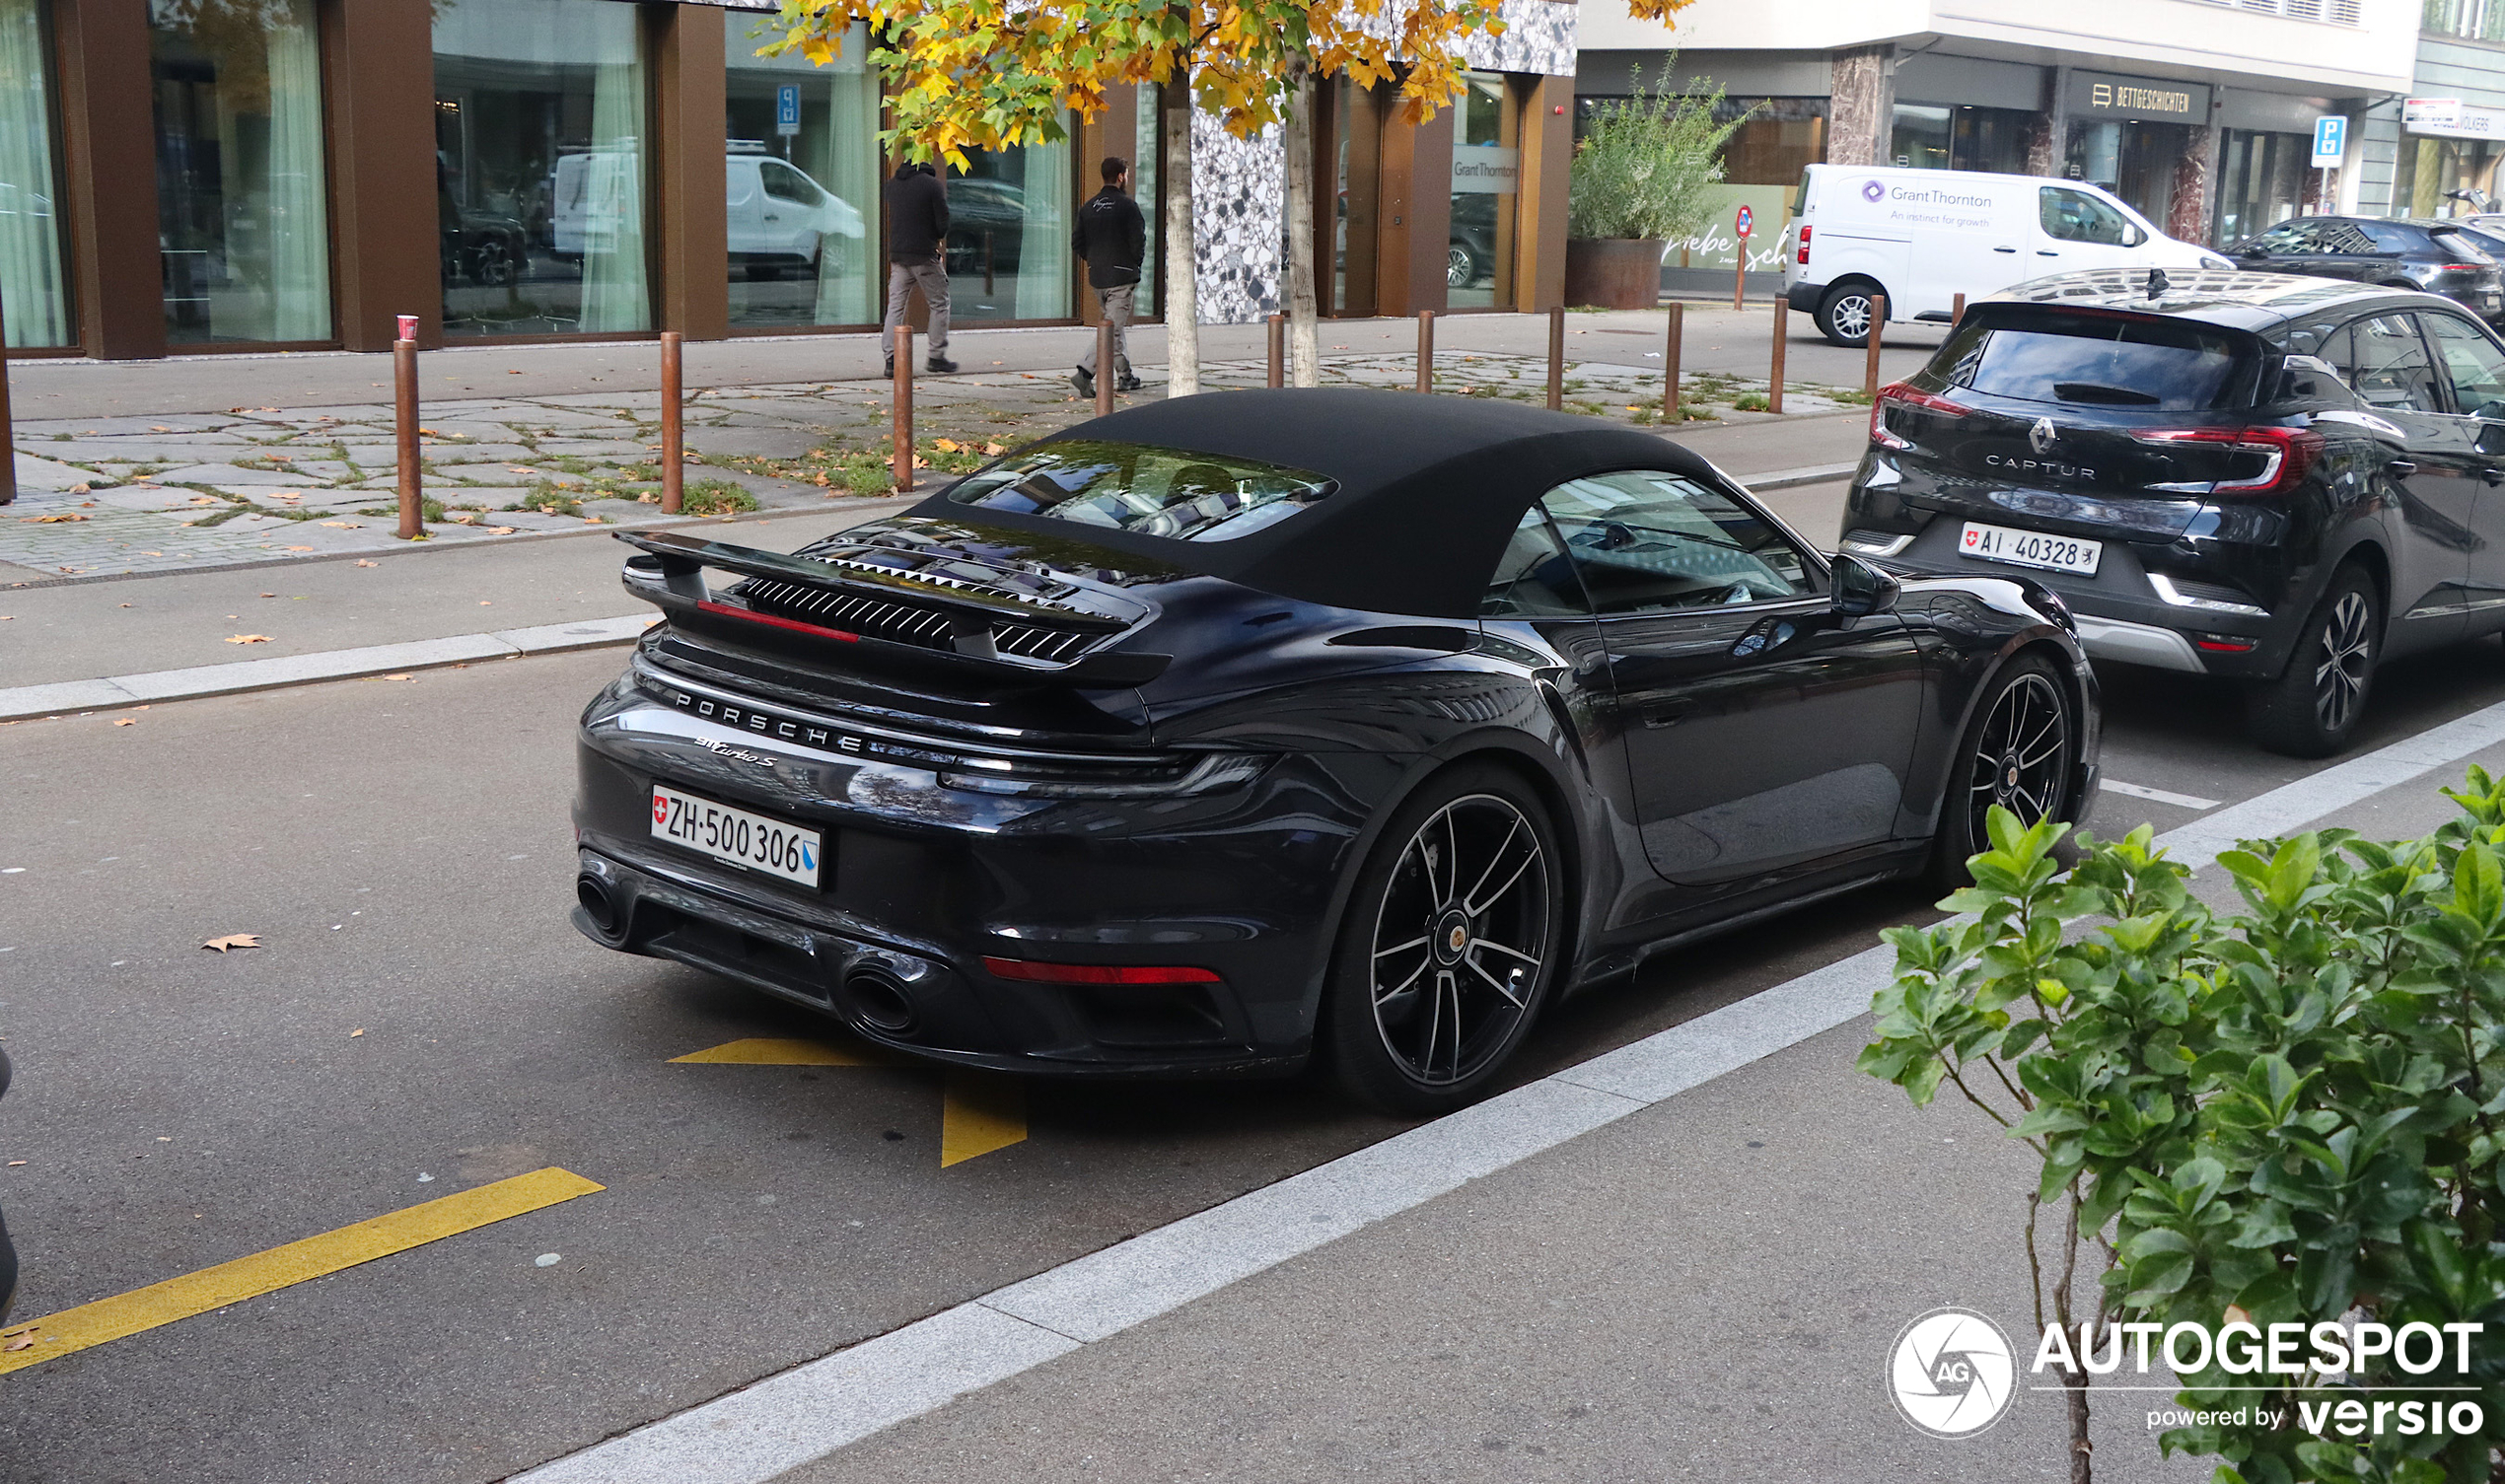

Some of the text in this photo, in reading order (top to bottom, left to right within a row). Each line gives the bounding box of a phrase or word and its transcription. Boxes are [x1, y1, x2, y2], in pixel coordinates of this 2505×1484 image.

[2116, 86, 2189, 112] BETTGESCHICHTEN
[2324, 121, 2337, 139] P
[1455, 162, 1518, 177] Grant Thornton
[1892, 186, 1991, 207] Grant Thornton
[1891, 210, 1989, 228] An instinct for growth
[1986, 455, 2096, 480] CAPTUR
[676, 693, 862, 752] PORSCHE
[756, 756, 778, 767] S
